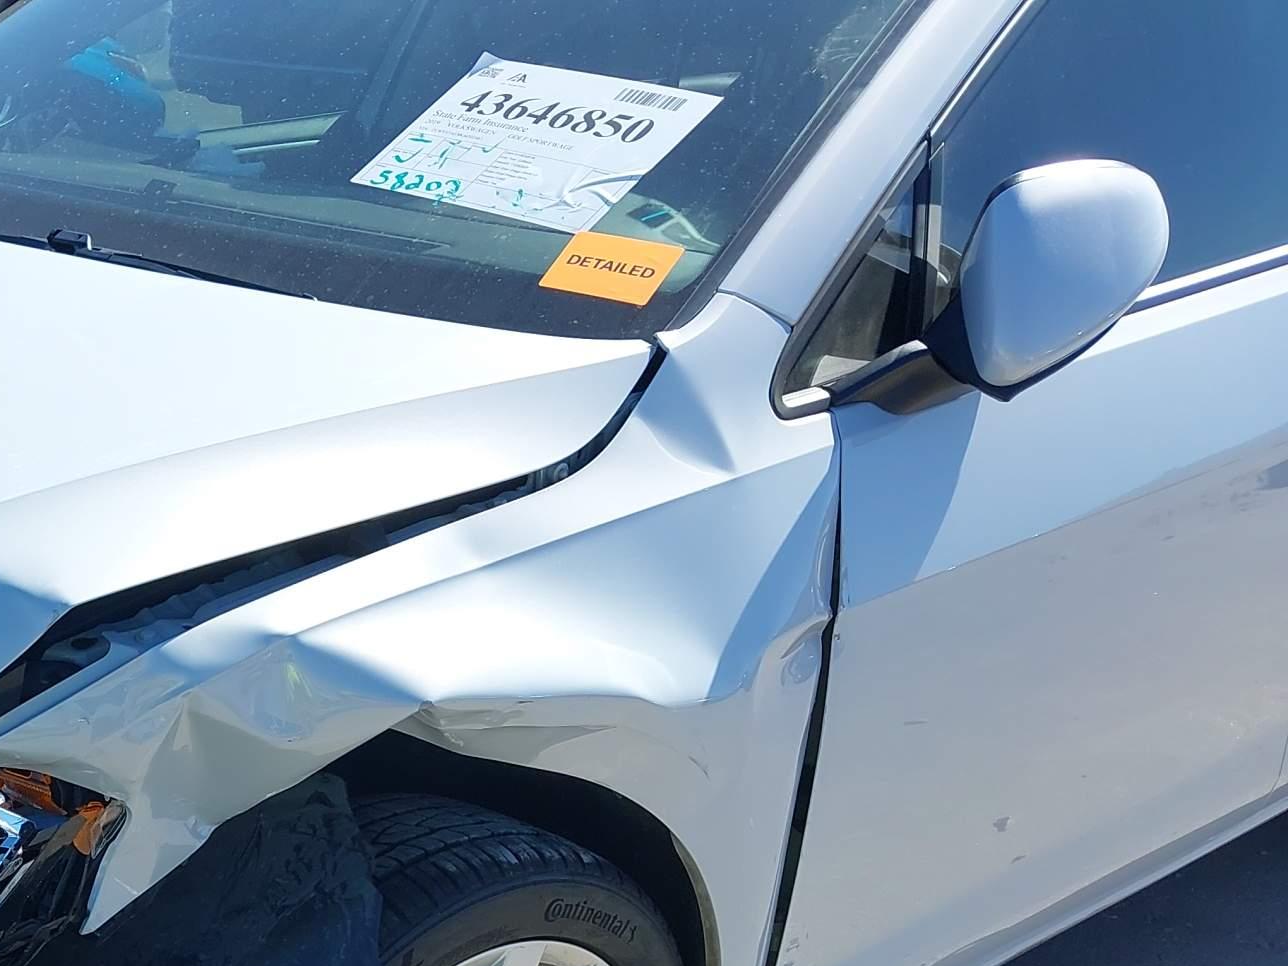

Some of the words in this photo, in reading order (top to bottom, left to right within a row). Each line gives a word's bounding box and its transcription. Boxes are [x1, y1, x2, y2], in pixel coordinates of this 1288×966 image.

[432, 109, 457, 121] State
[457, 113, 483, 126] Farm
[483, 117, 530, 134] Insurance
[460, 90, 655, 144] 43646850
[566, 253, 656, 280] DETAILED
[544, 898, 630, 939] Continental
